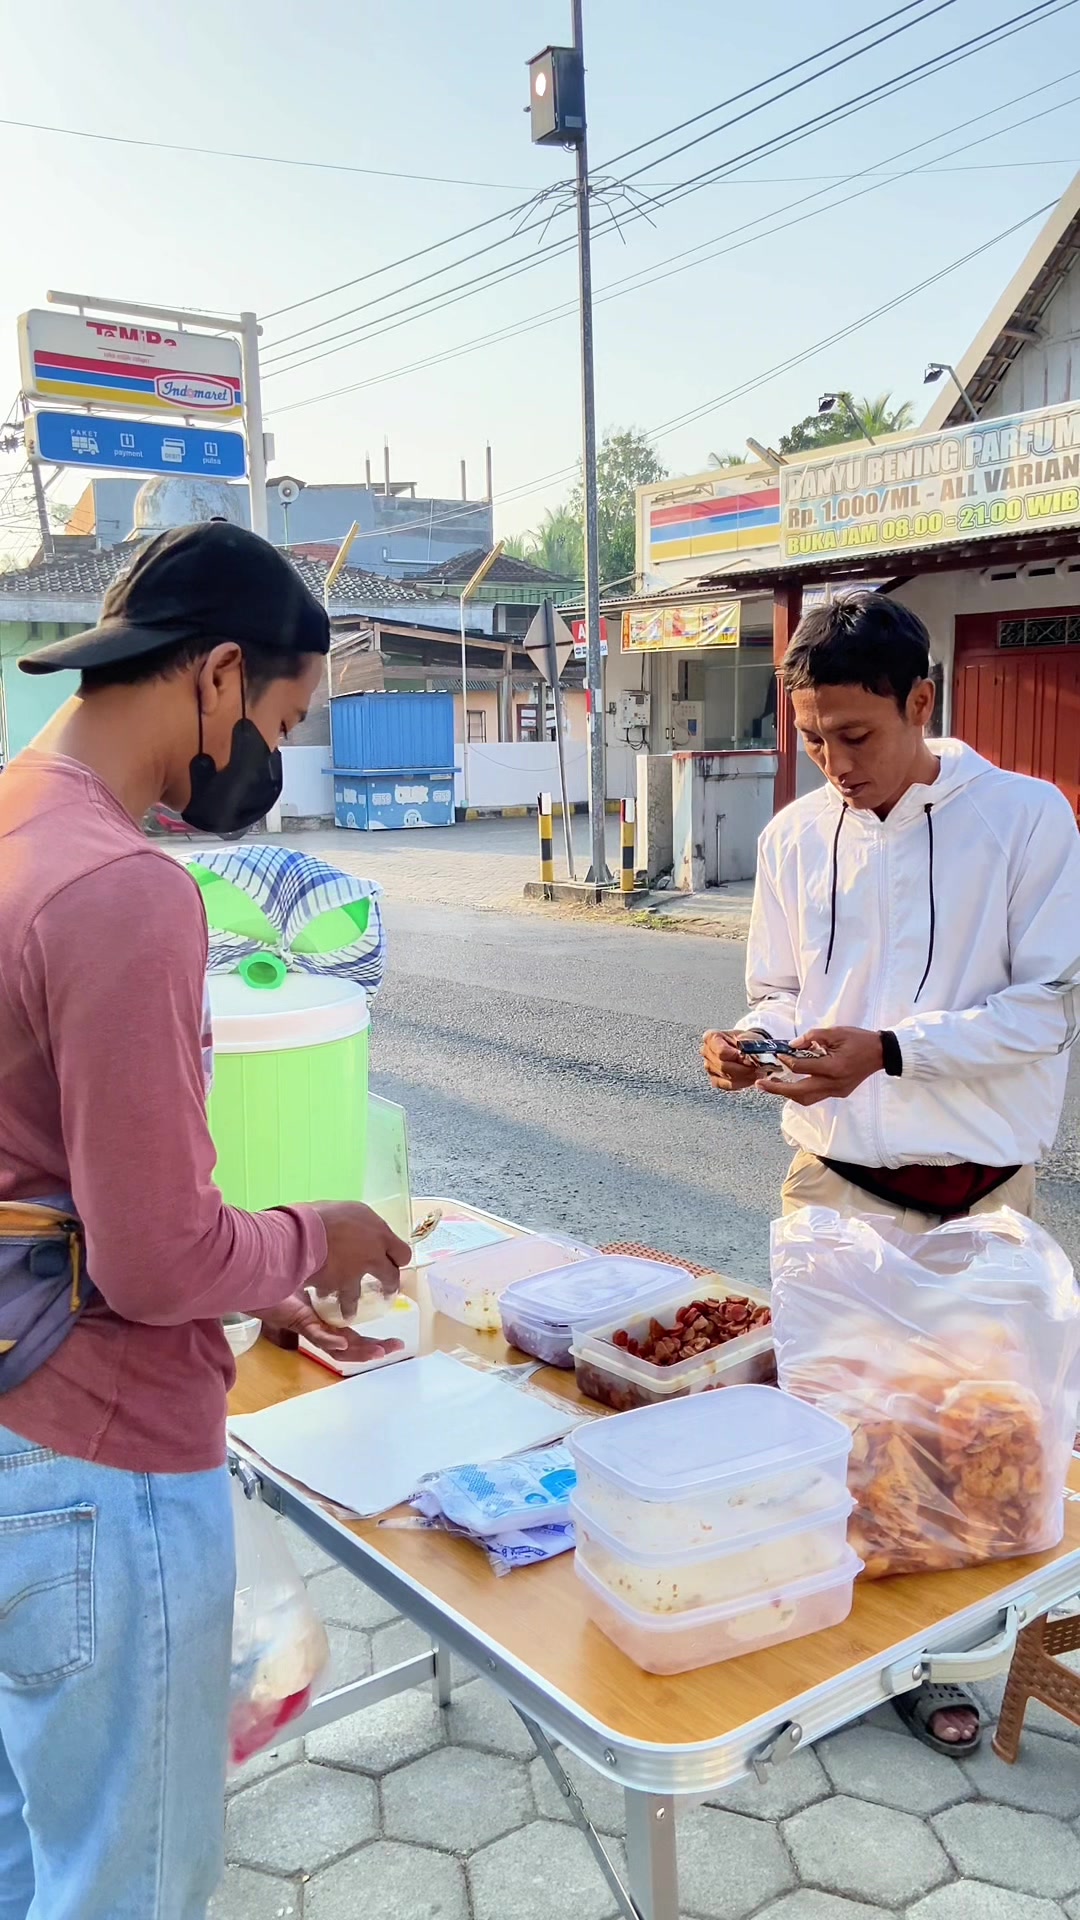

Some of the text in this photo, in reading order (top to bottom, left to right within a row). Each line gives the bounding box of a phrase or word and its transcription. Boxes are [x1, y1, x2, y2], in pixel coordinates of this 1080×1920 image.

[162, 381, 228, 401] Indomaret
[70, 428, 98, 438] PAKET
[114, 449, 144, 458] payment
[866, 439, 960, 487] BENING
[964, 411, 1080, 470] PARFUM
[202, 457, 221, 465] pulsa
[821, 488, 921, 522] 1.000/ML
[940, 472, 978, 502] ALL
[984, 454, 1080, 493] VARIAN
[787, 529, 837, 556] BUKA
[839, 522, 878, 548] JAM
[882, 512, 943, 542] 08.00
[959, 499, 1023, 530] 21.00
[1027, 488, 1079, 520] WIB
